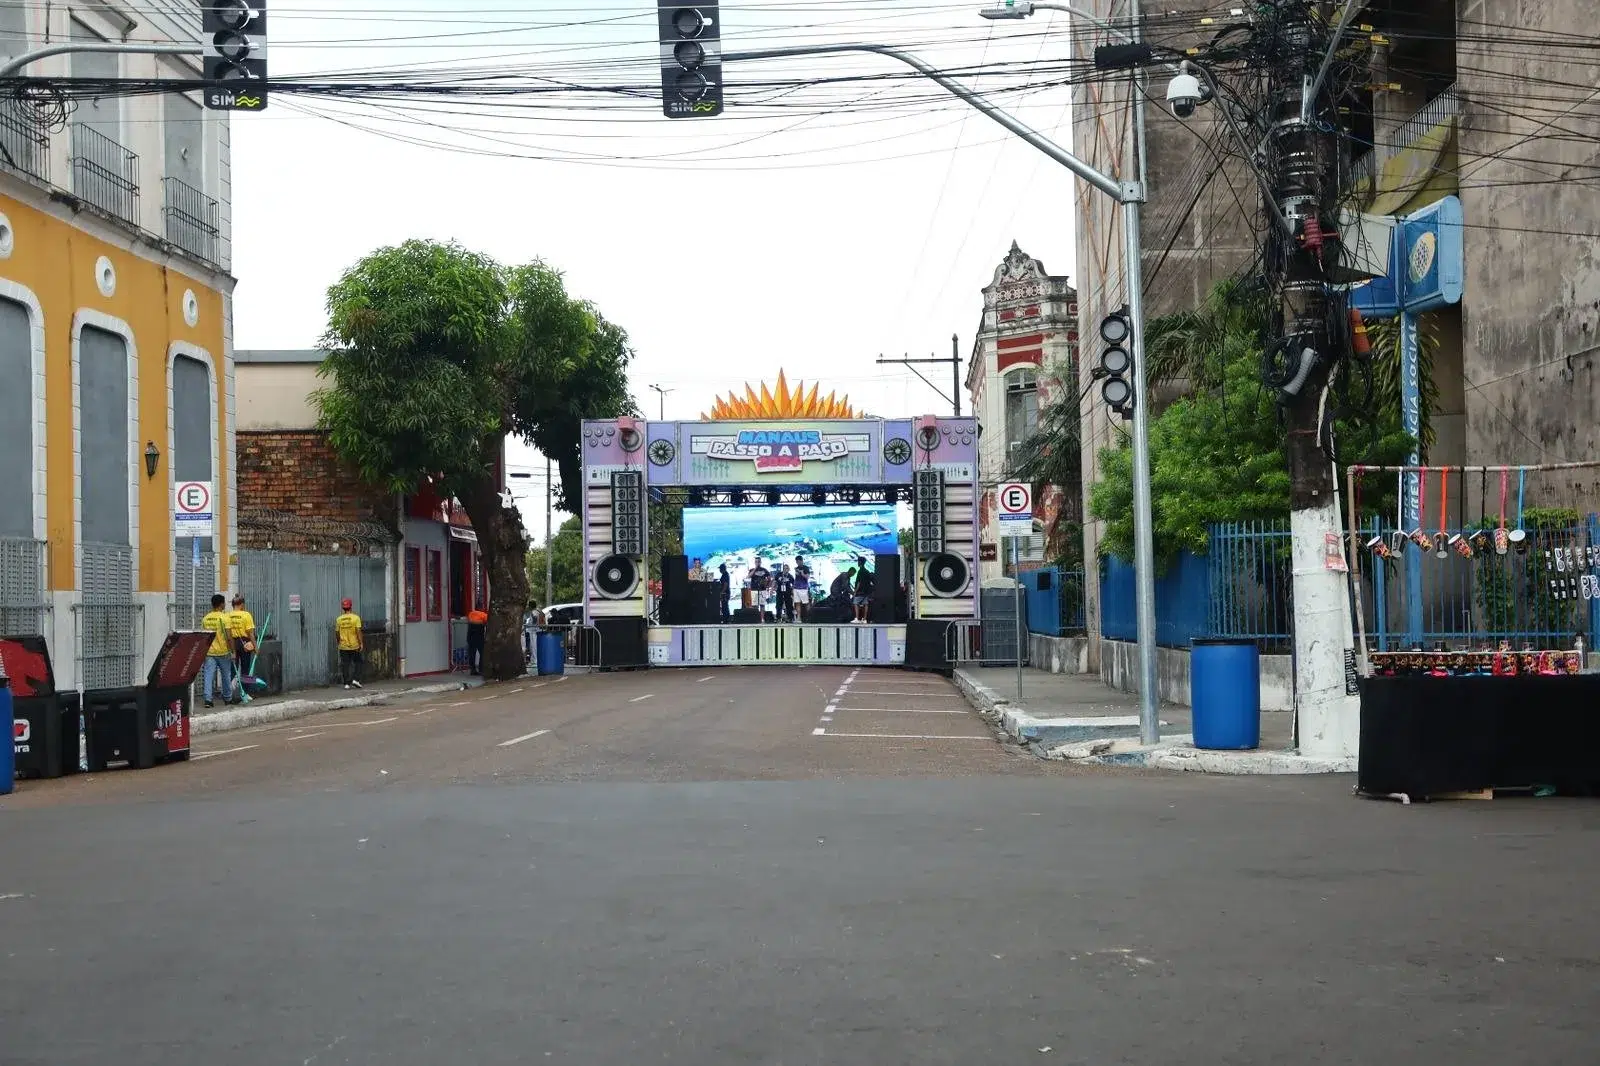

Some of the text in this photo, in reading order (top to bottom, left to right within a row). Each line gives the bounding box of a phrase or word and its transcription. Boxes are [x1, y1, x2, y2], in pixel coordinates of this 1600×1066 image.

[211, 94, 235, 106] SIM
[670, 102, 693, 112] SIM
[1408, 322, 1420, 521] PREVDNCIA SOCIAL
[738, 430, 821, 445] MANAUS
[712, 441, 845, 457] PASSO A PAÇO
[187, 489, 200, 506] E
[1009, 491, 1020, 506] E
